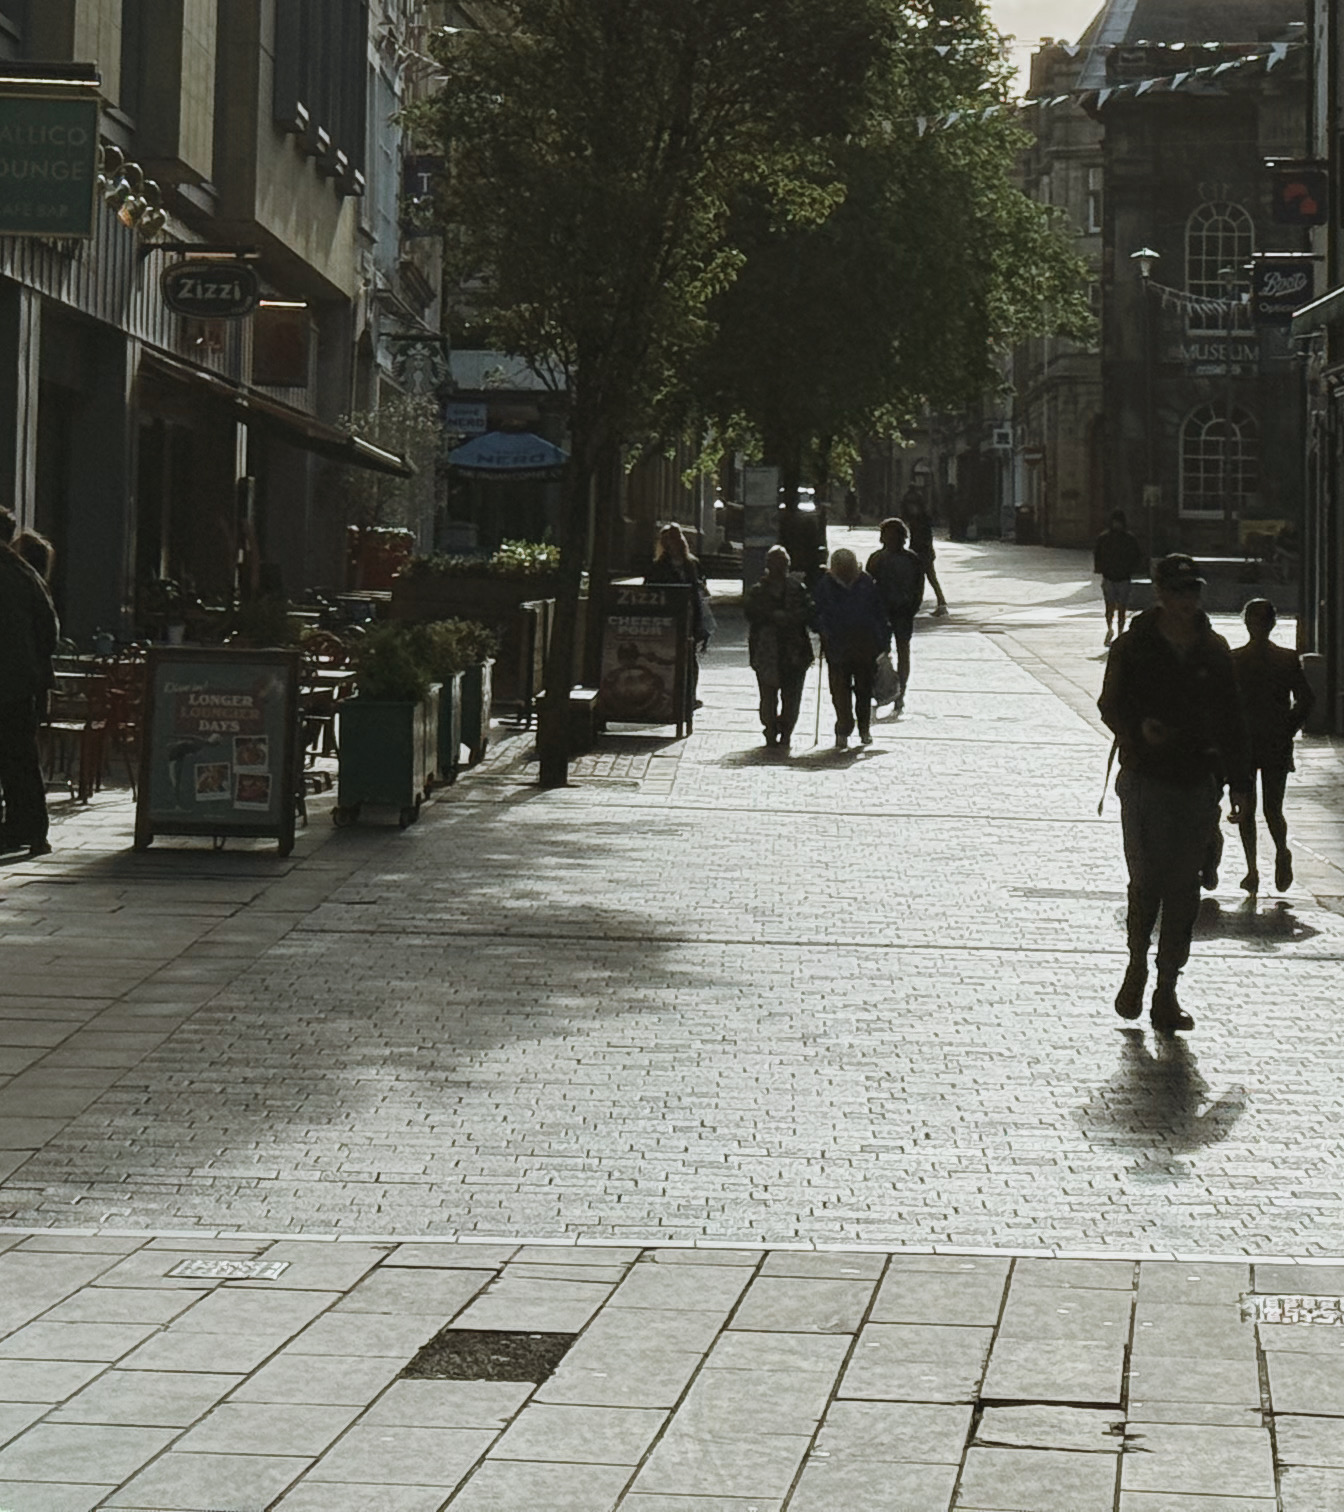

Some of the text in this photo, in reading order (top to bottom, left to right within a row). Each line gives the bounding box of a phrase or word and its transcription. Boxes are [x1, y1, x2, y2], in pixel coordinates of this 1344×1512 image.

[178, 279, 243, 301] Zizzi
[1257, 271, 1308, 297] Boots
[1179, 343, 1260, 361] MUSEUM
[615, 589, 667, 606] Zizzi
[188, 693, 255, 708] LONGER
[198, 719, 241, 733] DAYS
